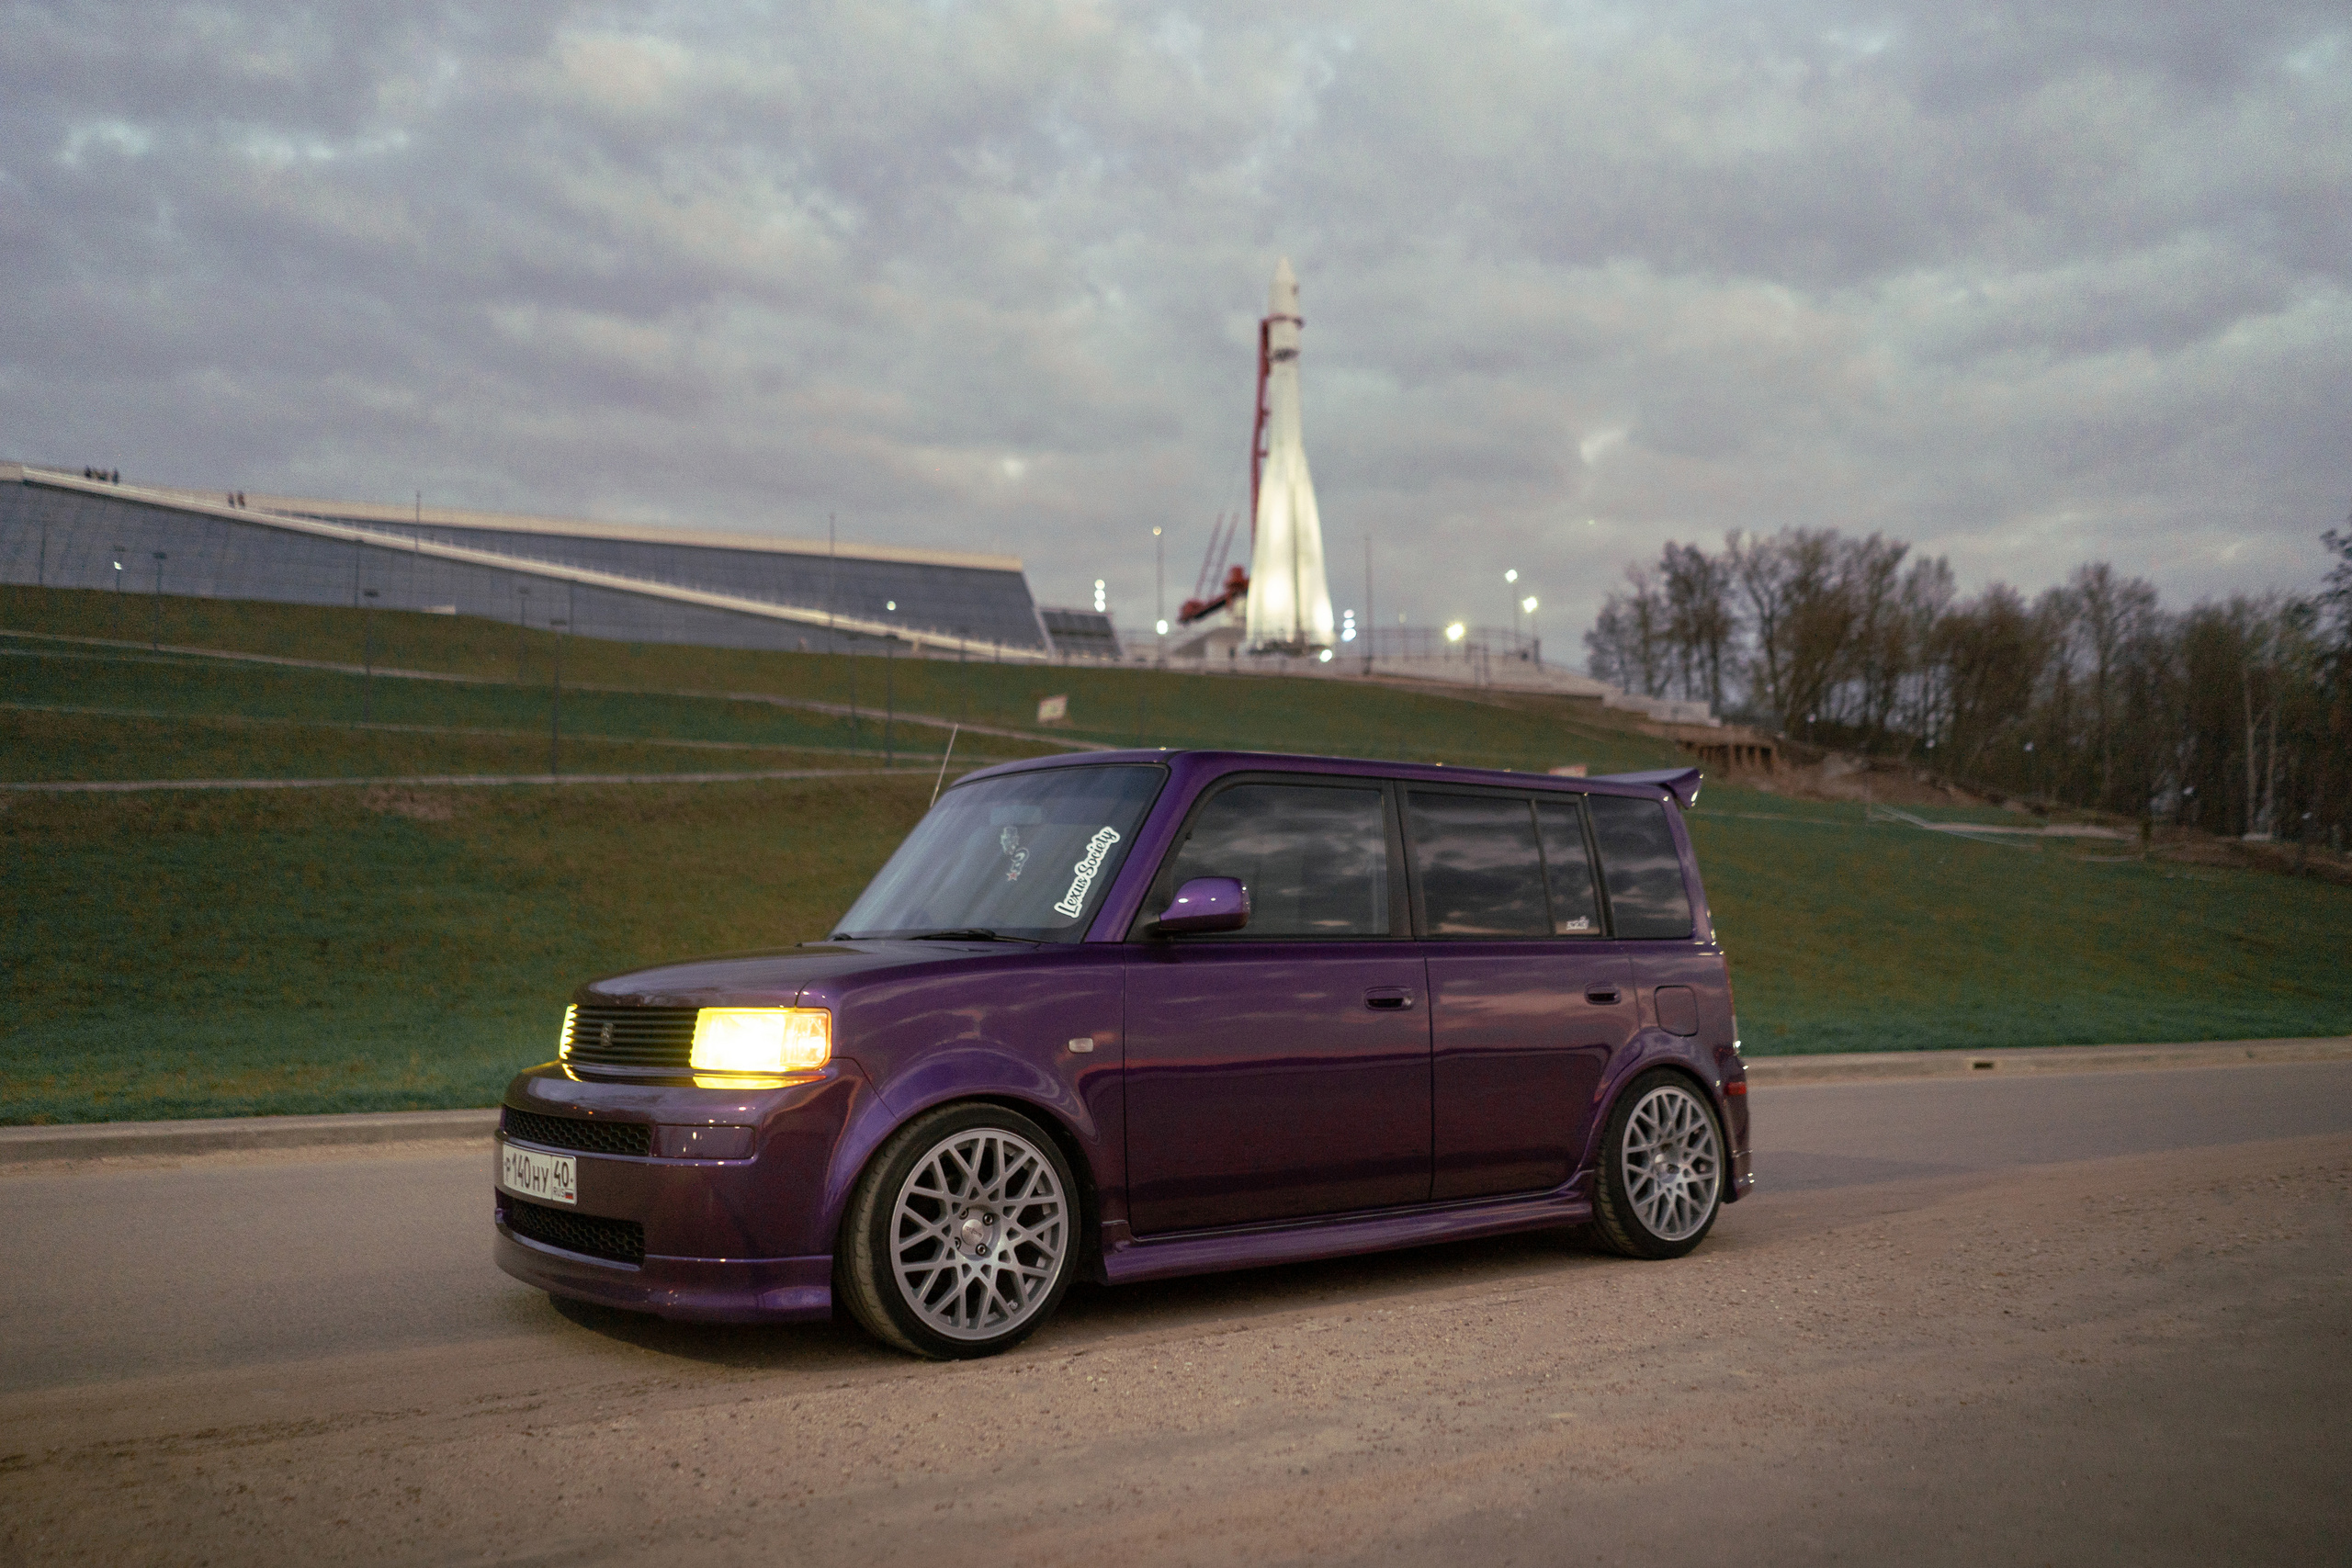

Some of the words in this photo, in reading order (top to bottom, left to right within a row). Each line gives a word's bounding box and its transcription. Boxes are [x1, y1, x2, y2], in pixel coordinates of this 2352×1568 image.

[1057, 875, 1088, 915] Lexus
[1078, 829, 1117, 876] Society
[553, 1160, 570, 1187] 40
